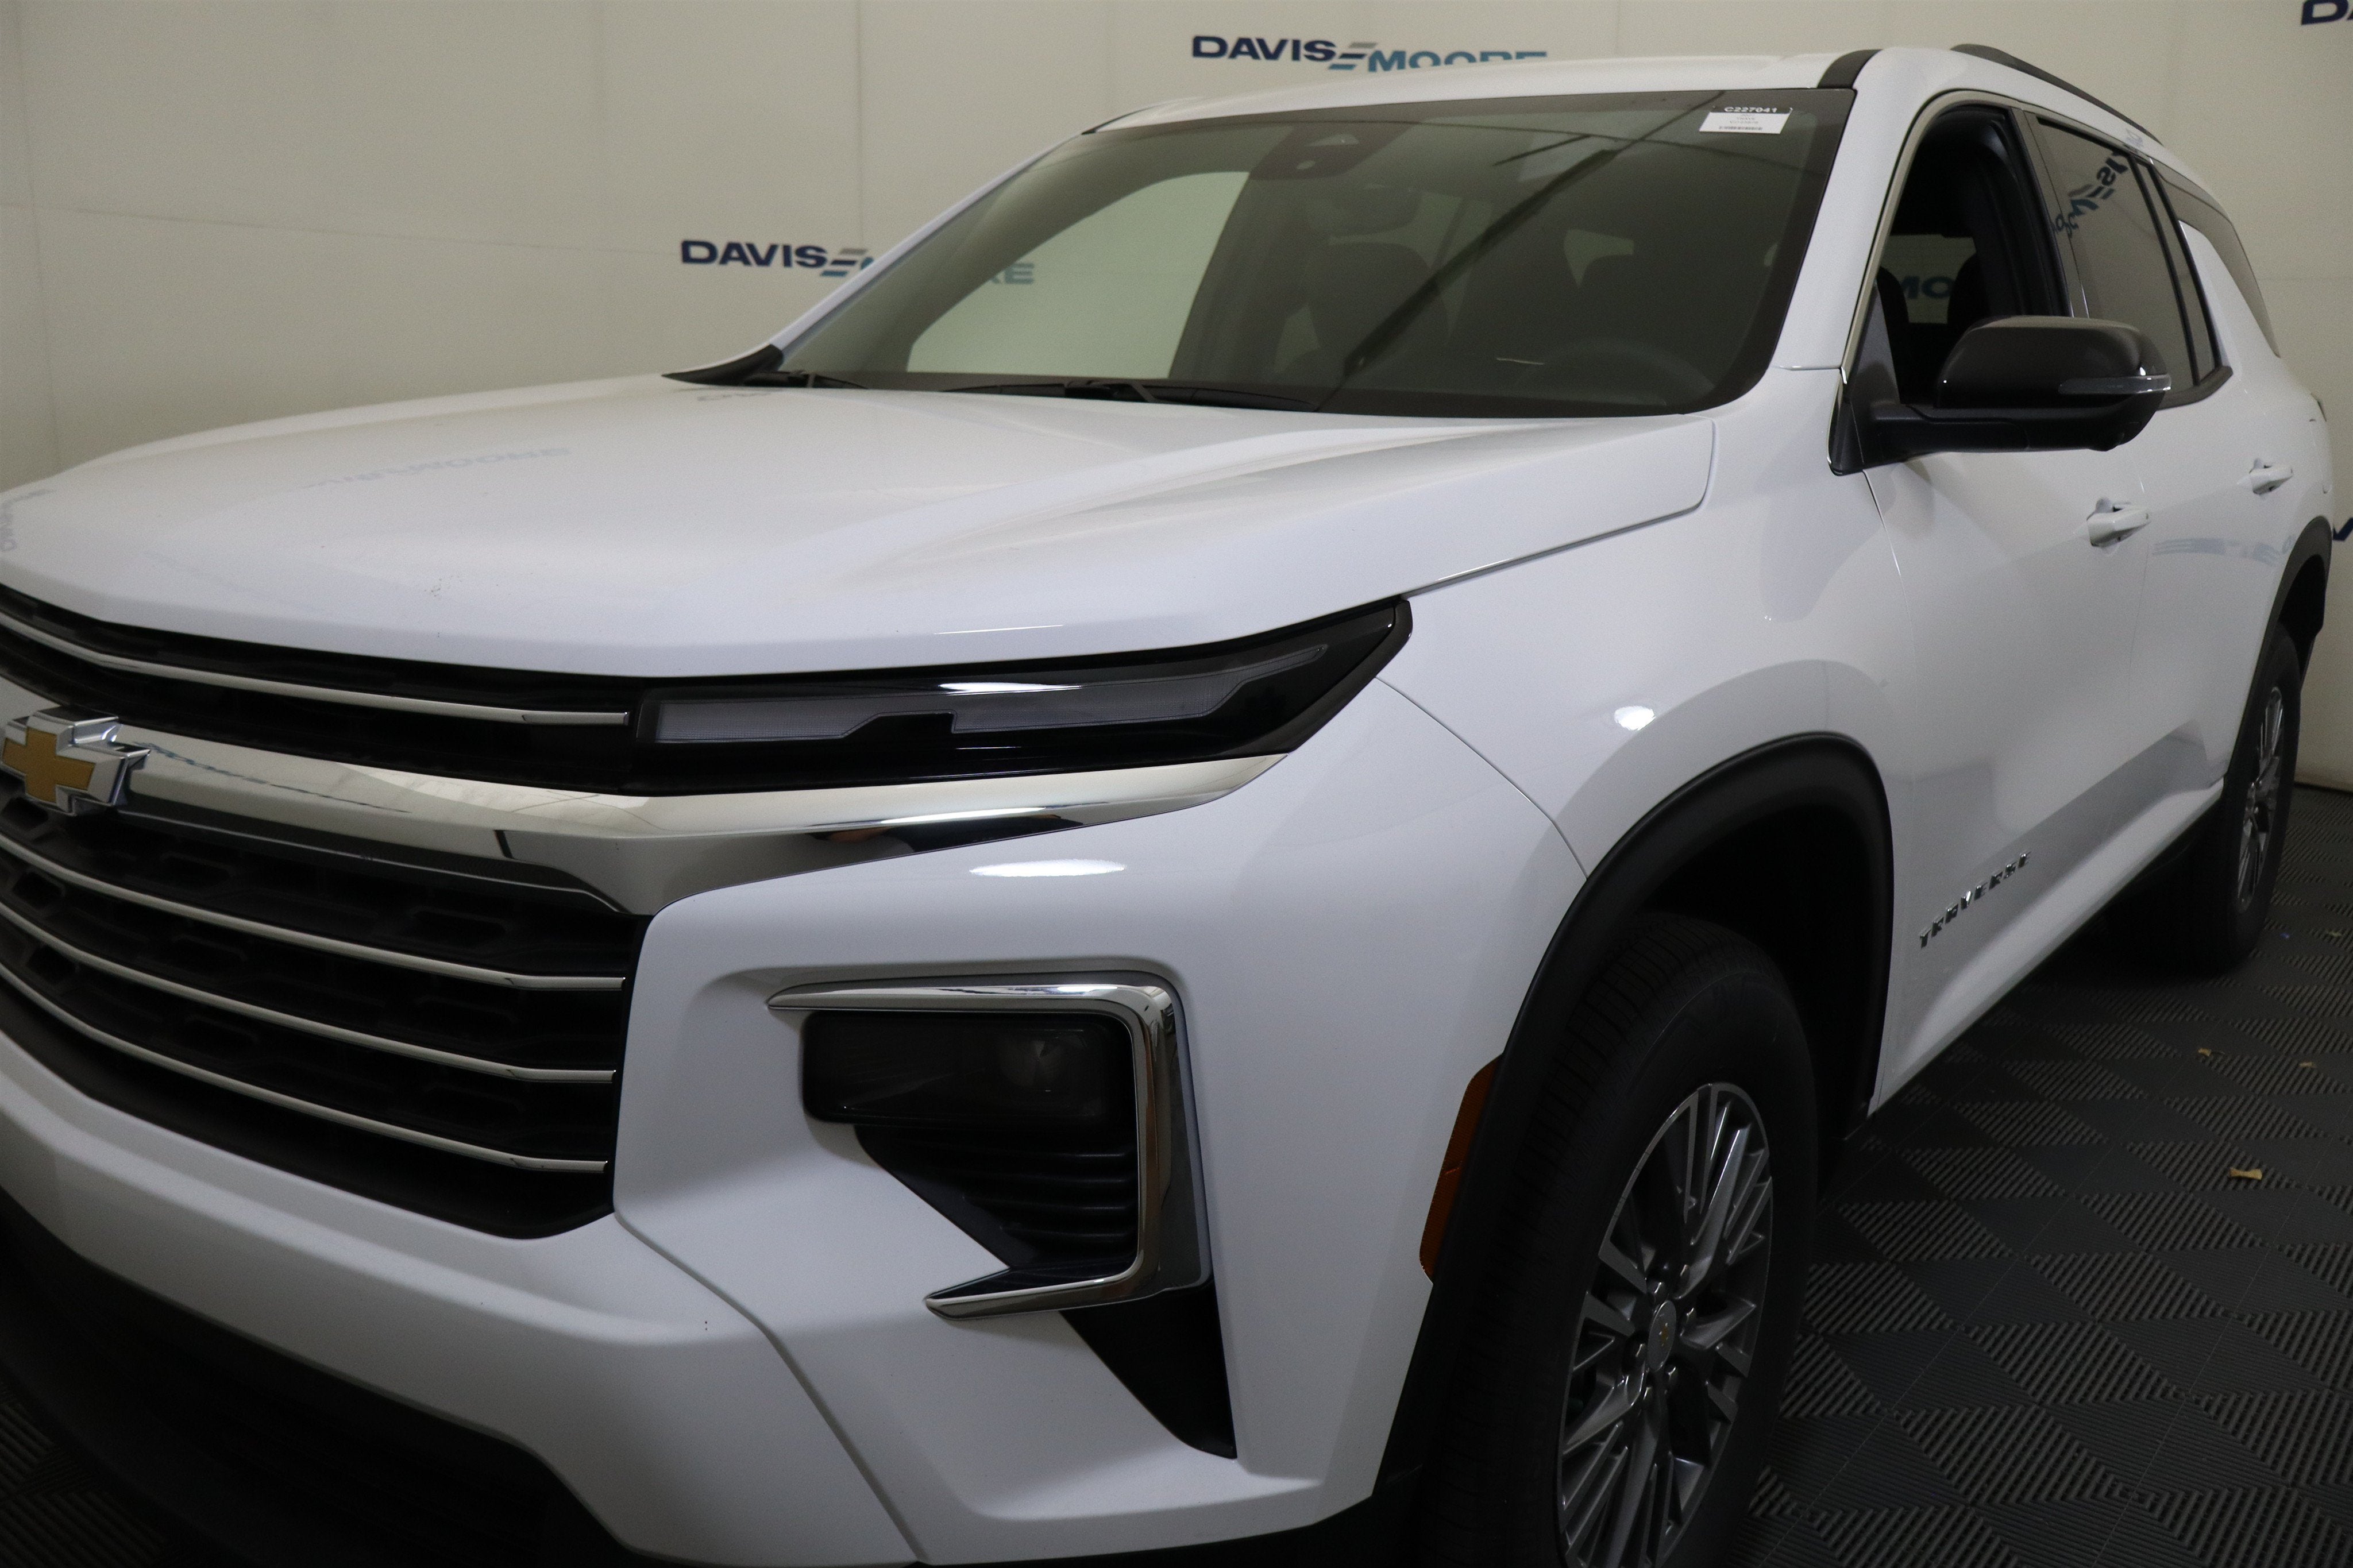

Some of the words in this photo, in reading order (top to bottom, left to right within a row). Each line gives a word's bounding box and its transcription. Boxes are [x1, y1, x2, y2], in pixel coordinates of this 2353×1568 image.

[1193, 36, 1336, 62] DAVIS
[681, 240, 827, 268] DAVIS
[1920, 851, 2031, 948] TRAVERSE
